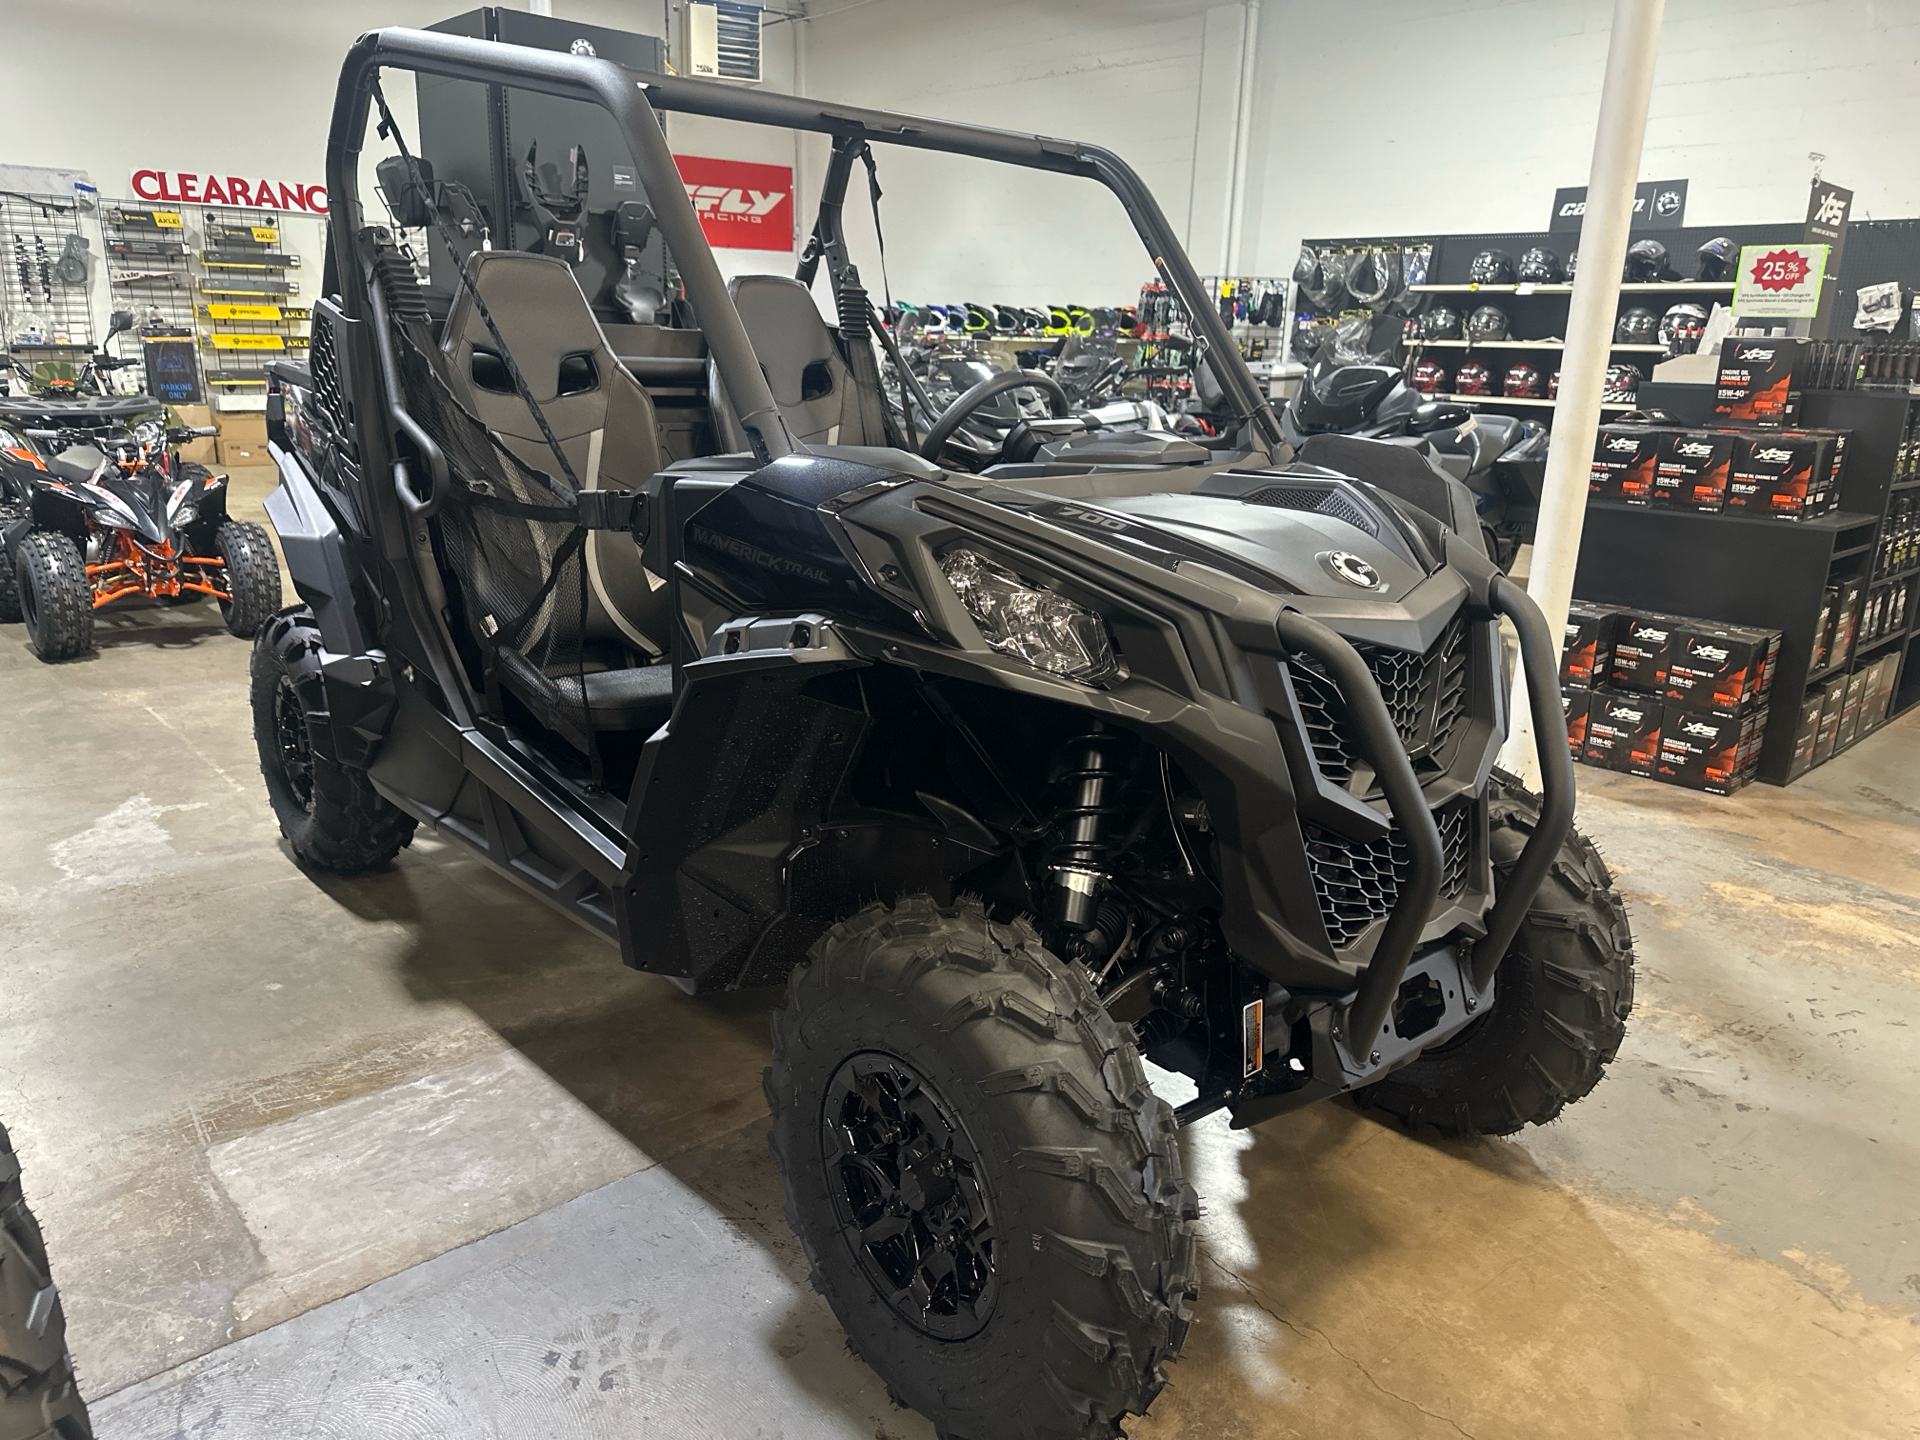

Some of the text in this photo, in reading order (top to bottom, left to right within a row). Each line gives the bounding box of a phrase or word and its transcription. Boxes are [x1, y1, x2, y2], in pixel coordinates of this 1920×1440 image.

[697, 211, 762, 224] ACING
[1784, 272, 1800, 281] OFF
[1738, 347, 1776, 360] XPS
[160, 383, 193, 391] PARKING
[168, 391, 187, 399] ONLY
[1606, 437, 1640, 450] XPS
[1677, 442, 1714, 455] XPS
[1754, 447, 1794, 461] XPS
[1058, 506, 1128, 531] 700
[693, 526, 830, 583] MAVERICK TRAIL
[1633, 627, 1669, 641] XPS
[1690, 644, 1730, 660] XPS
[1608, 706, 1644, 721] XPS
[1682, 722, 1720, 737] XPS
